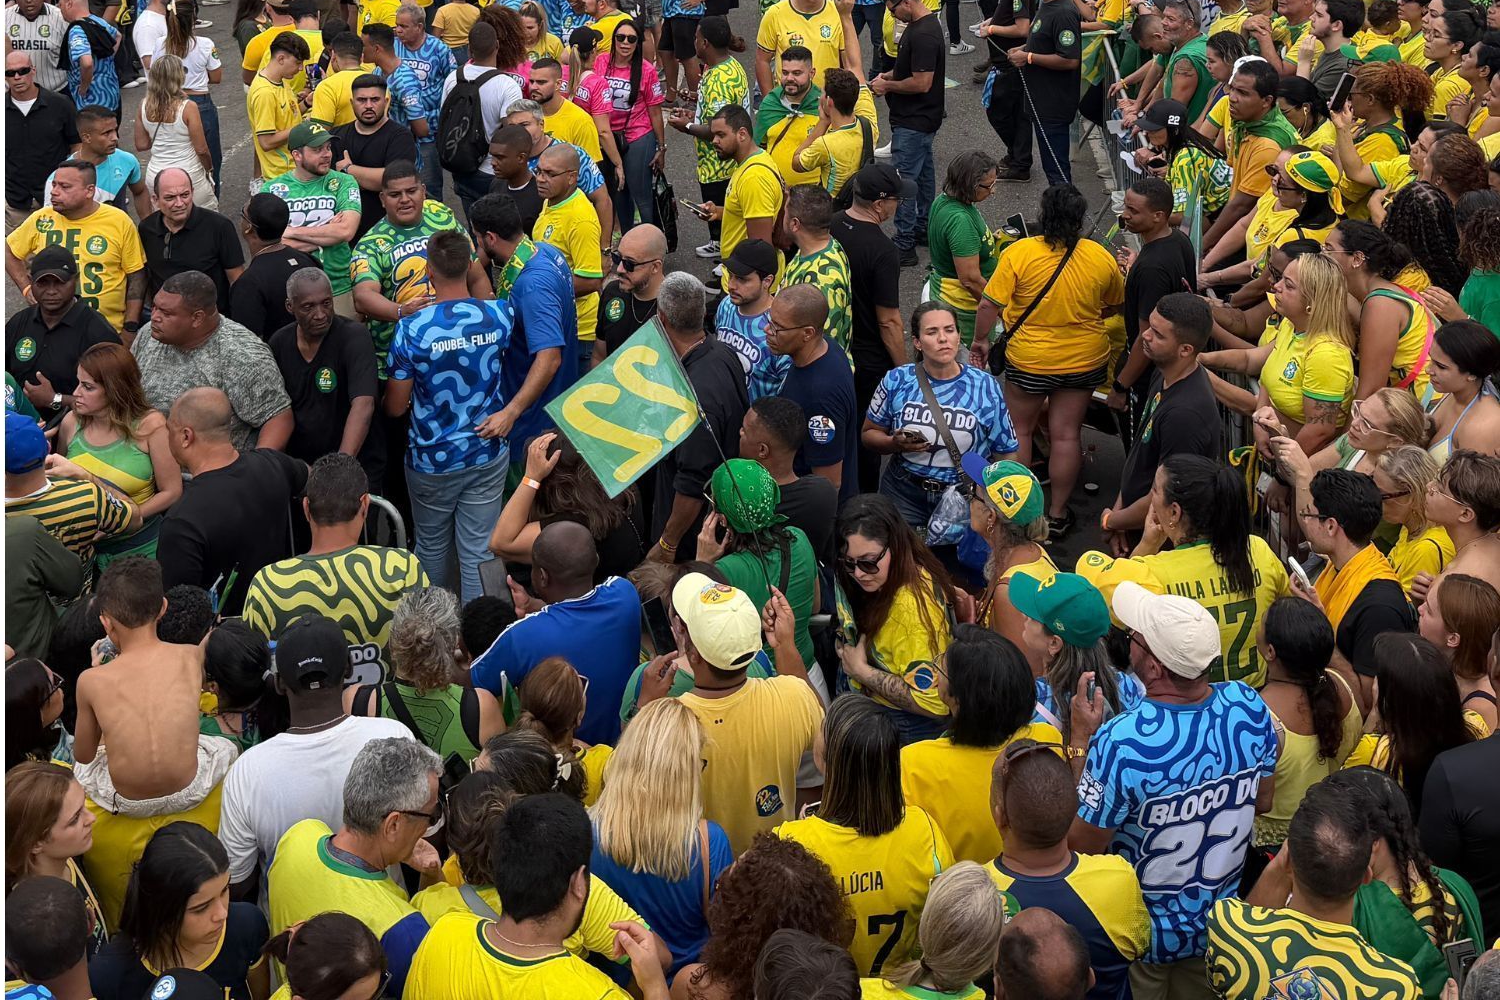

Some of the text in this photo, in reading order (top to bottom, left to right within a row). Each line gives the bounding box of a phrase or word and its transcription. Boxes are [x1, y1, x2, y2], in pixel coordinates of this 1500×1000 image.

[11, 39, 50, 52] BRASIL
[309, 123, 325, 135] 22
[1167, 114, 1181, 126] 22
[288, 198, 335, 212] LOCO DO
[432, 332, 498, 354] POUBEL FILHO
[717, 329, 758, 361] BLOCO DO
[321, 368, 331, 378] 22
[809, 419, 821, 429] 22
[955, 413, 976, 430] DO
[1167, 580, 1206, 599] LULA
[1077, 779, 1100, 809] 22
[1149, 772, 1259, 826] BLOCO DO
[1141, 806, 1255, 886] 22
[841, 870, 884, 896] LÚCIA
[868, 910, 909, 978] 7
